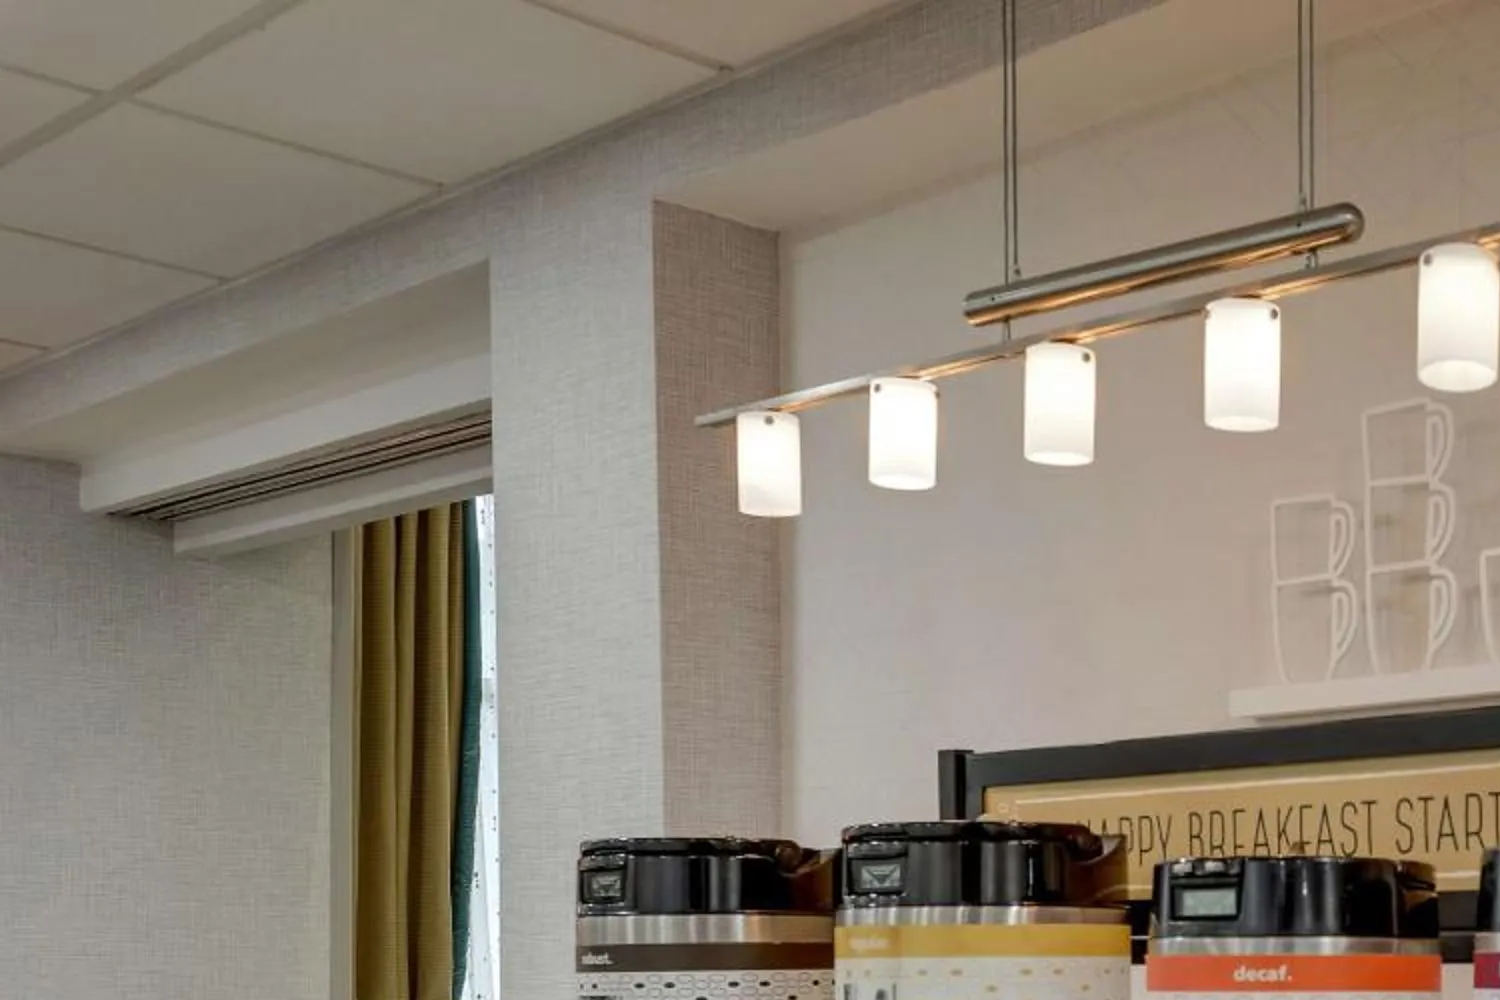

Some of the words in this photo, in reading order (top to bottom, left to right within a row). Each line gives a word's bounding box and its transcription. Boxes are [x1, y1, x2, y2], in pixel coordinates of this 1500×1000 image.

[1078, 814, 1173, 866] PPY
[1188, 799, 1378, 858] BREAKFAST
[1233, 964, 1293, 983] decaf.
